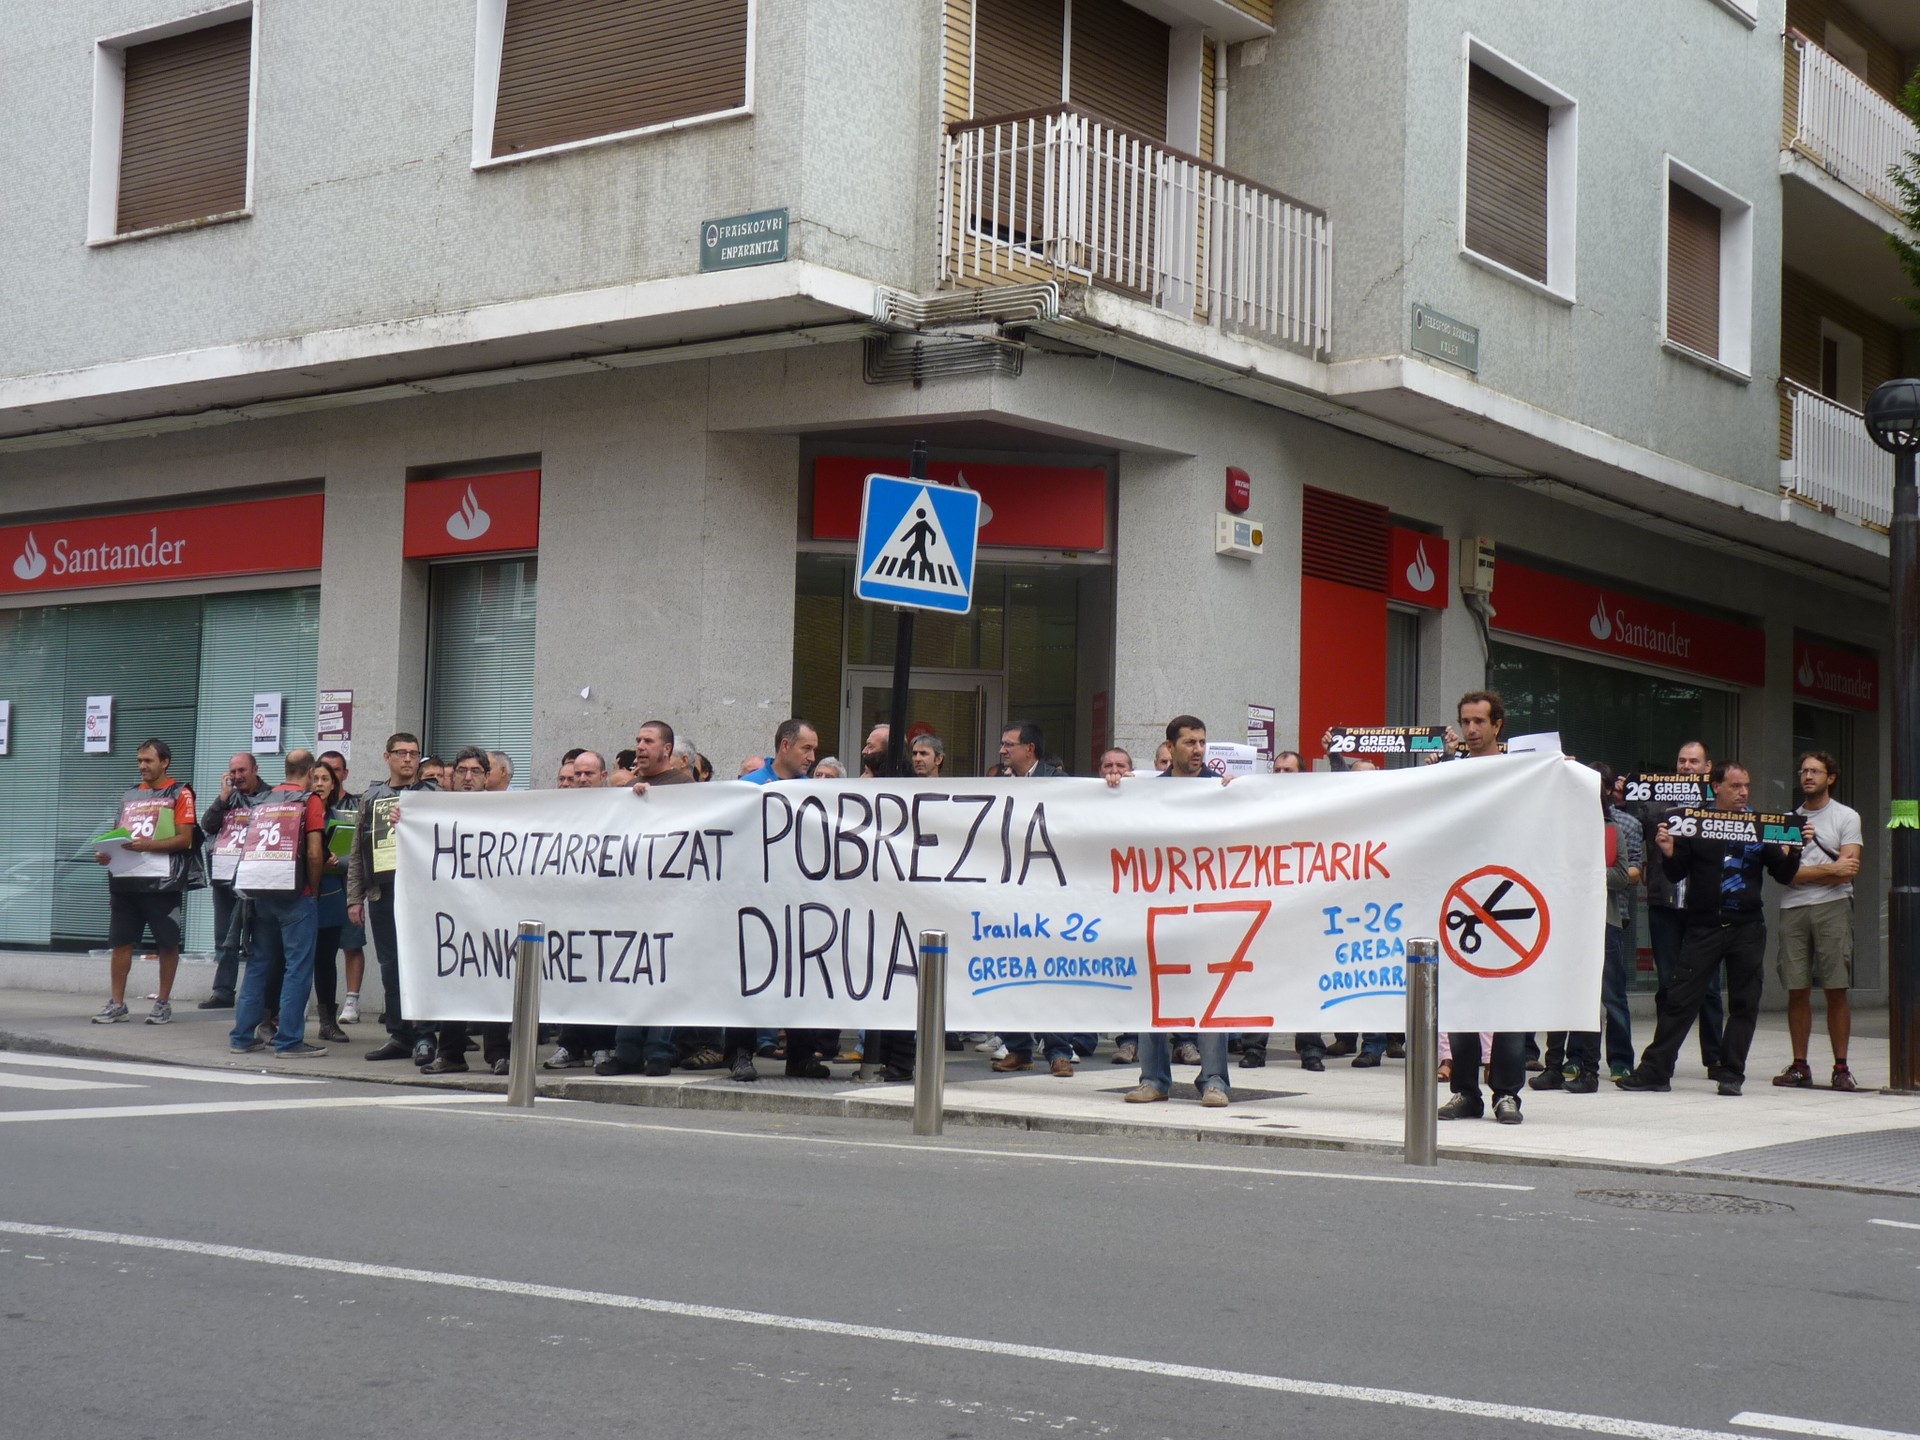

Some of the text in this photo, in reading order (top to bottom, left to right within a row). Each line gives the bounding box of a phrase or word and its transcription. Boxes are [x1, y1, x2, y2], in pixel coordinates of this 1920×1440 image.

[721, 240, 780, 260] ENPARANTZA
[52, 526, 186, 577] Santander
[1615, 609, 1691, 658] Santander
[1816, 660, 1873, 700] Santander
[1330, 735, 1356, 753] 26
[1359, 735, 1406, 746] GREBA
[1346, 728, 1430, 736] Pobreziarik EZ!!
[1625, 782, 1651, 801] 26
[1654, 782, 1701, 794] GREBA
[1639, 774, 1700, 782] Pobreziarik
[1654, 793, 1703, 802] OROKORRA
[131, 815, 154, 840] 26
[1667, 815, 1803, 842] 26 GREBA ELA
[1685, 808, 1786, 824] Pobreziarik EZ!!
[255, 822, 281, 851] 26
[762, 791, 1067, 887] POBREZIA
[1701, 830, 1758, 843] OROKORRA
[431, 821, 734, 881] HERRITARRENTZAT
[1110, 840, 1391, 895] MURRIZKETARIK
[971, 911, 1102, 943] Irailak 26
[1321, 902, 1404, 935] I-26
[435, 912, 674, 986] BANKRETZAT
[738, 902, 919, 1001] DIRUA
[1335, 937, 1406, 965] GREBA
[968, 956, 1138, 981] GREBA OROKORRA
[1146, 900, 1275, 1028] EZ
[1318, 965, 1407, 991] OROKORR
